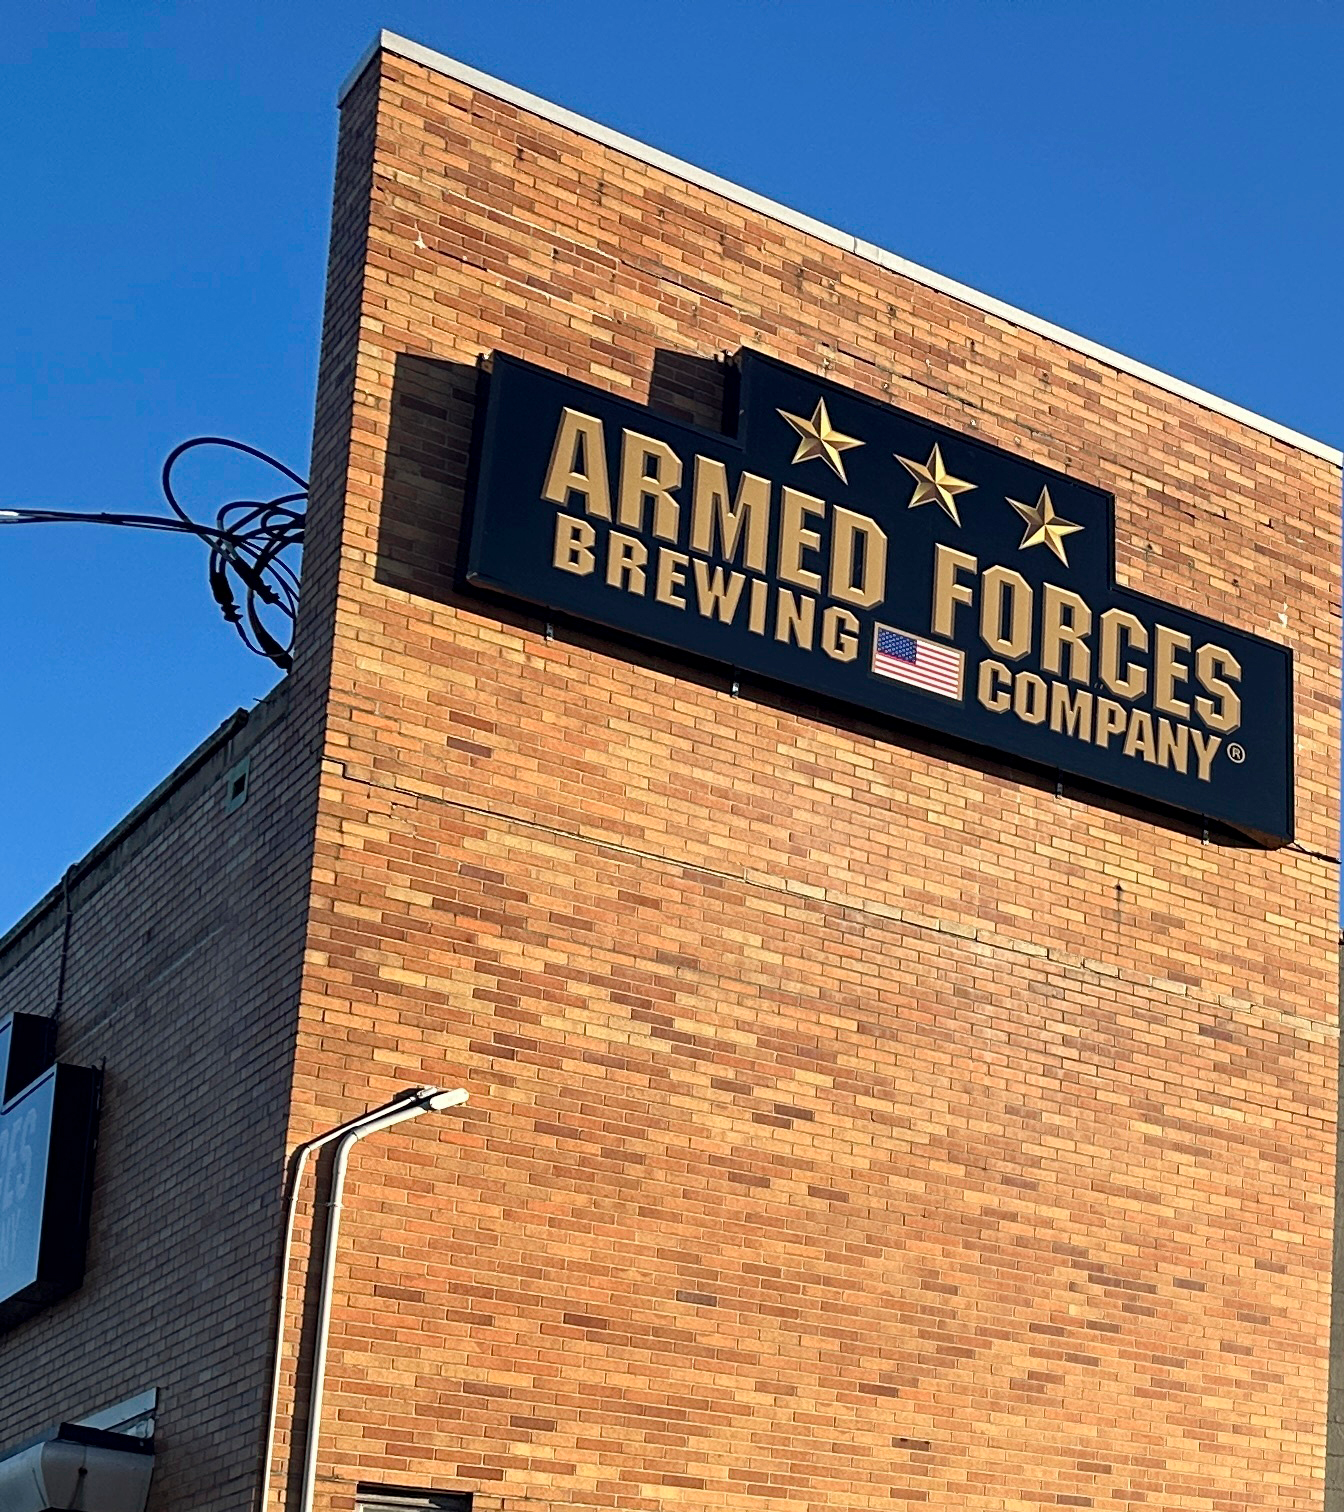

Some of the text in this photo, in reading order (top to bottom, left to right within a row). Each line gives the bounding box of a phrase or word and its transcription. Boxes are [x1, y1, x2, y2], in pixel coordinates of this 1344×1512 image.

[541, 406, 1243, 735] ARMED FORCES
[554, 512, 861, 663] BREWING
[977, 658, 1222, 783] COMPANY
